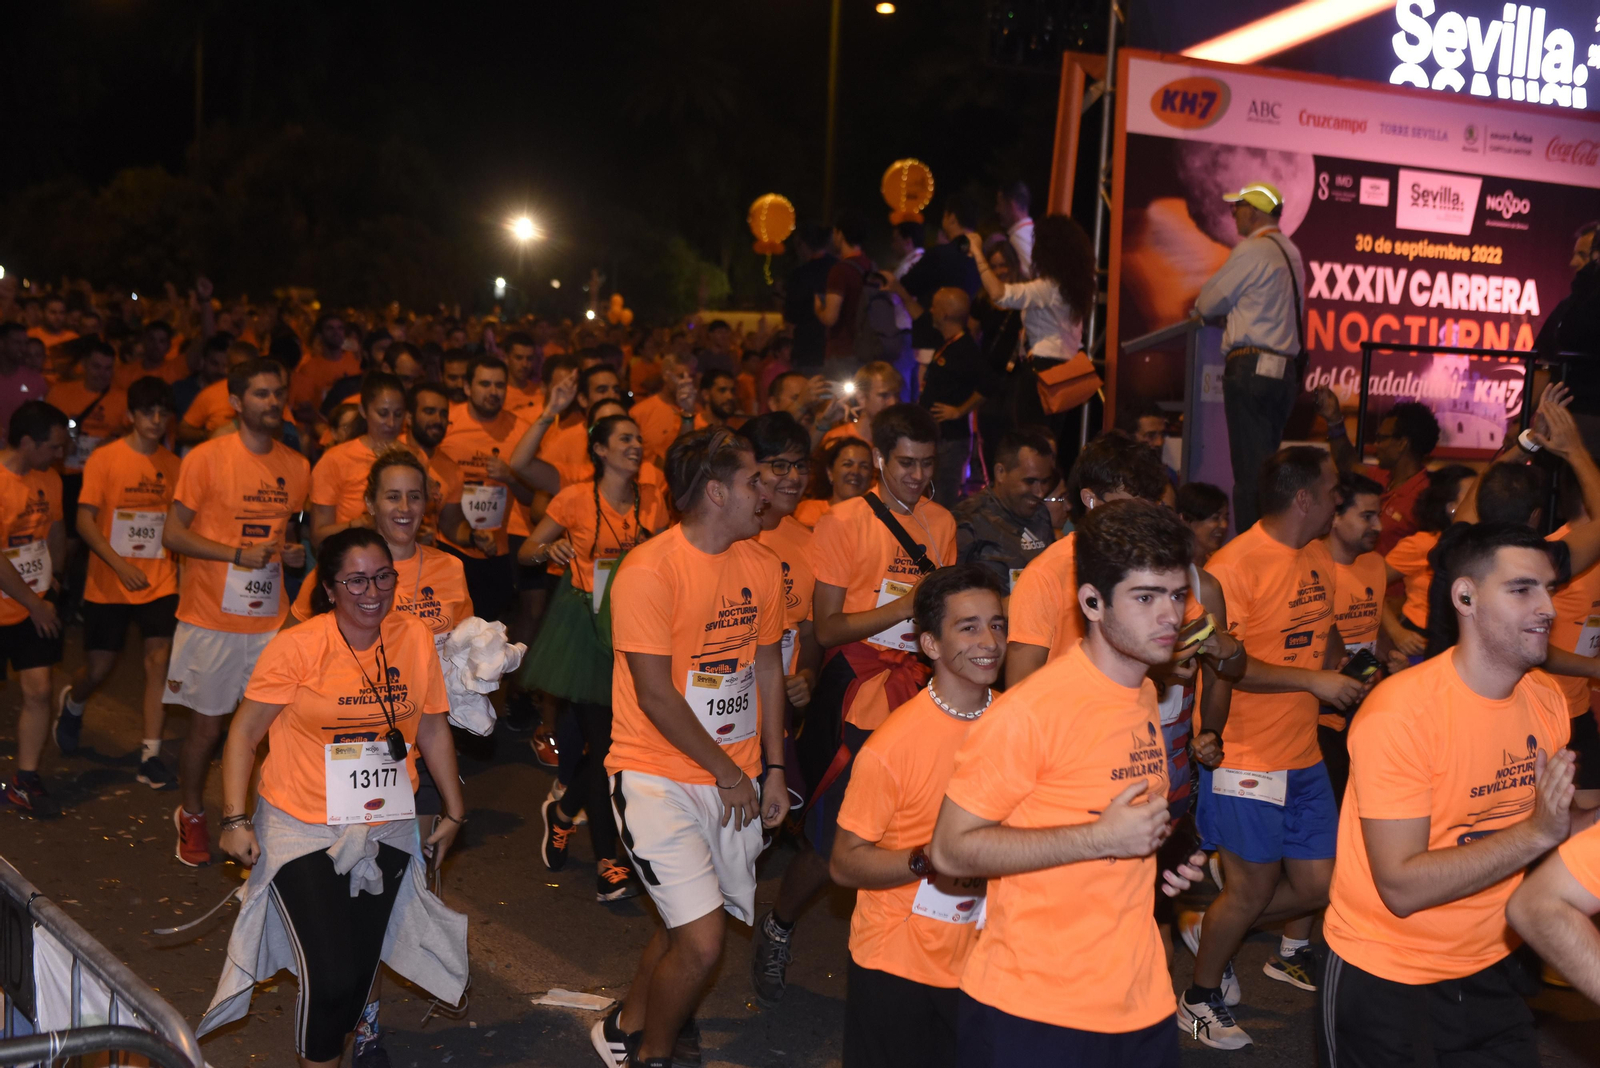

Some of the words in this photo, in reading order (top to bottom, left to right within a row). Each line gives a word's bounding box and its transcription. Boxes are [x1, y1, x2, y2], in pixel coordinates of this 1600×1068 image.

[1248, 101, 1282, 118] ABC
[1299, 109, 1368, 135] Cruzcampo
[1380, 122, 1408, 136] TORRE
[1411, 124, 1448, 142] SEVILLA
[1354, 233, 1373, 252] 30
[1374, 235, 1393, 254] de
[1394, 238, 1471, 262] septiembre
[1471, 244, 1503, 265] 2022
[1308, 261, 1407, 305] XXXIV
[1409, 269, 1540, 316] CARRERA
[1306, 308, 1534, 363] NOCTURNA
[469, 500, 498, 512] 14074
[128, 526, 156, 539] 3493
[19, 558, 43, 576] 3255
[245, 580, 272, 595] 4949
[718, 605, 758, 618] NOCTURNA
[705, 617, 739, 632] SEVILLA
[337, 694, 381, 706] SEVILLA
[706, 692, 749, 716] 19895
[1129, 748, 1163, 763] NOCTURNA
[349, 768, 398, 789] 13177
[1110, 762, 1147, 781] SEVILLA
[1495, 761, 1536, 780] NOCTUR
[1470, 778, 1518, 799] SEVILLA
